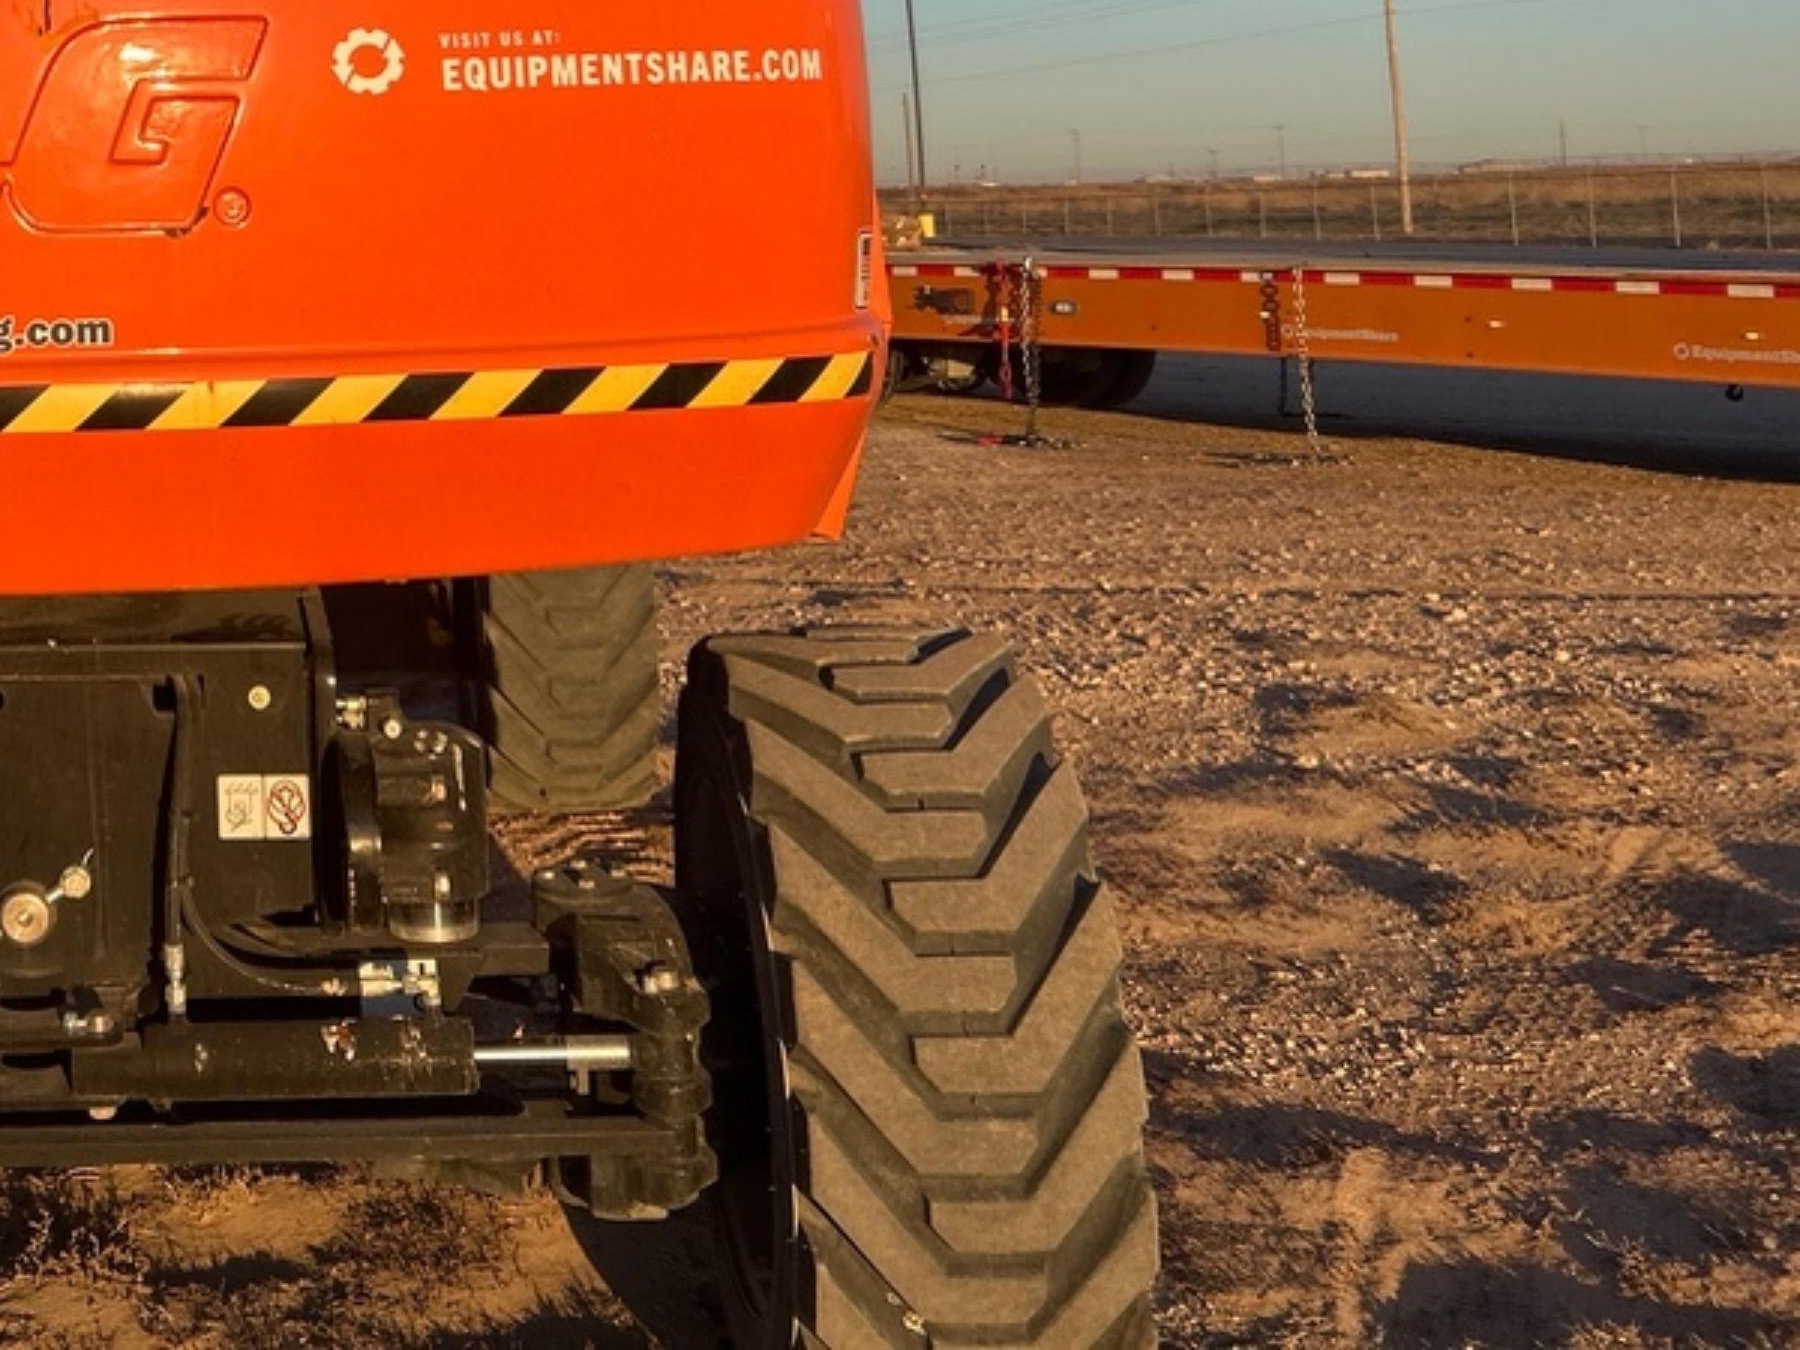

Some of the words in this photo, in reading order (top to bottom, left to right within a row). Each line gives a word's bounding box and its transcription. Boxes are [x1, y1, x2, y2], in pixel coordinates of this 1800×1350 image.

[439, 31, 490, 49] VISIT
[499, 30, 523, 47] US
[442, 48, 823, 92] EQUIPMENTSHARE.COM
